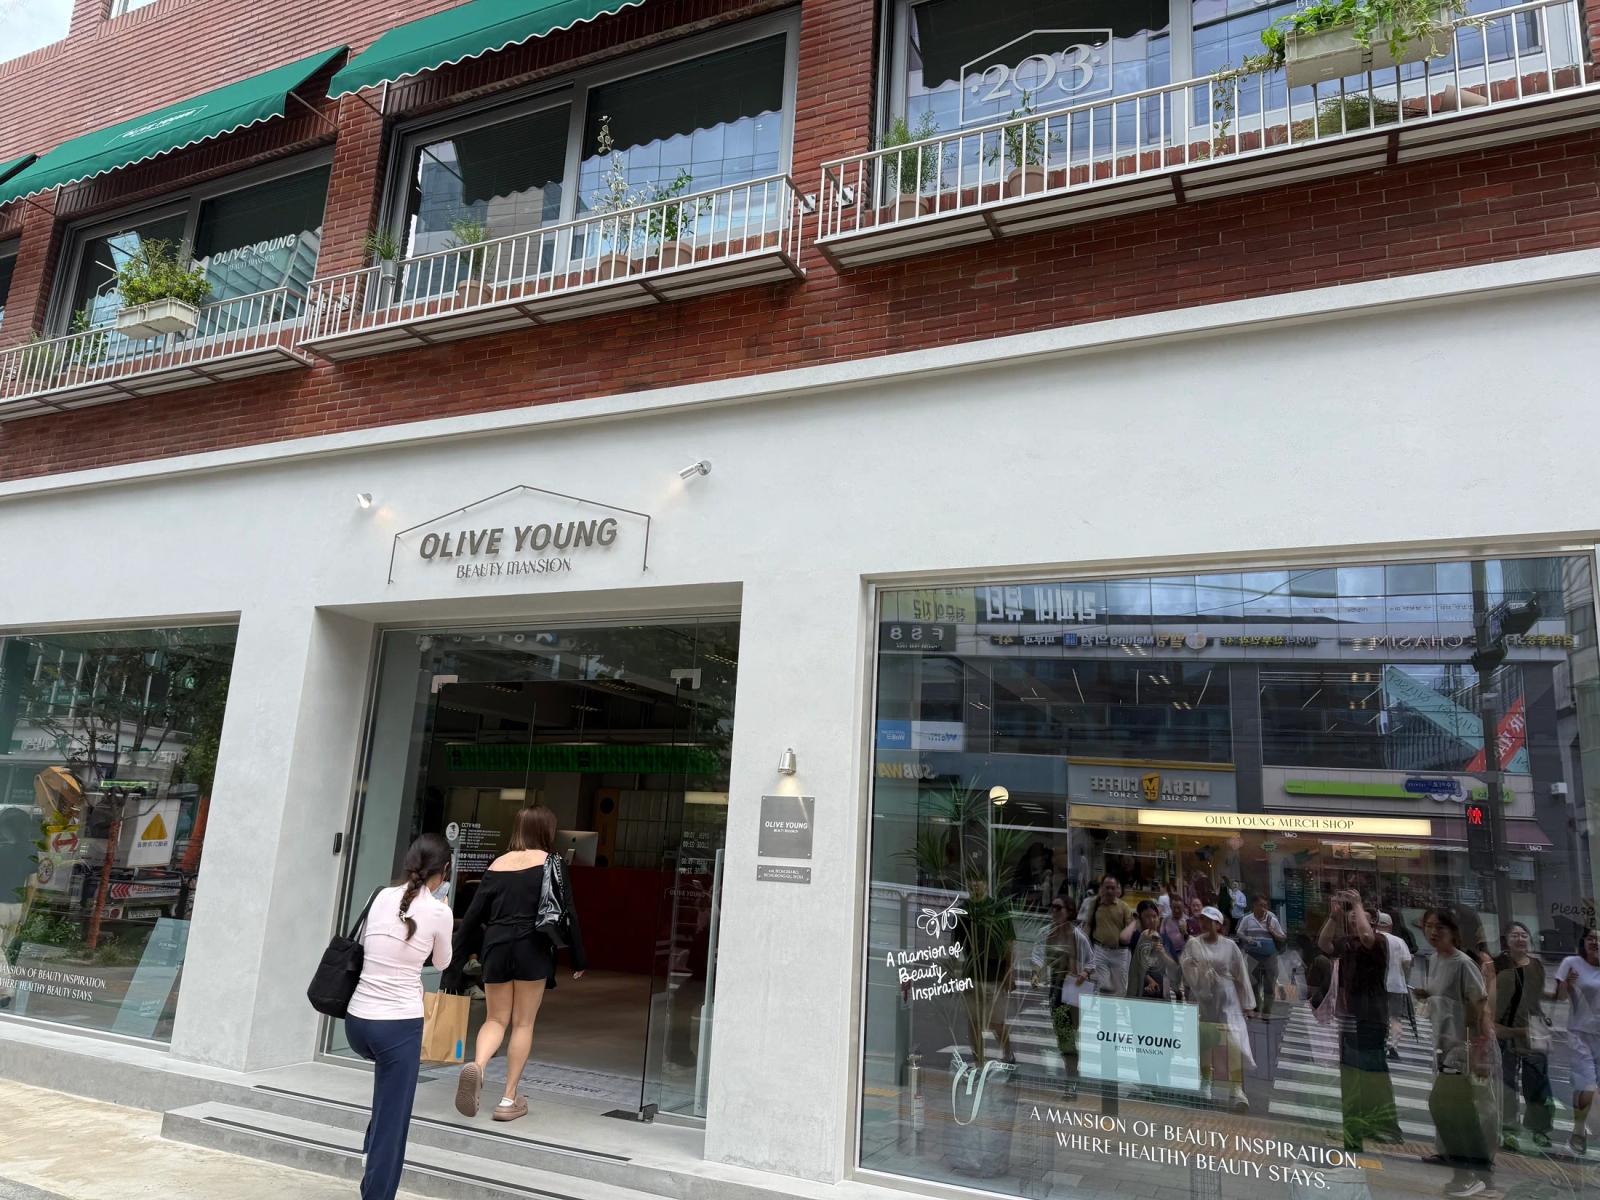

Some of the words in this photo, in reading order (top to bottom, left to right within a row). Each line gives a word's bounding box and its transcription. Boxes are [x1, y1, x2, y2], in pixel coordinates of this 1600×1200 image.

[213, 244, 250, 268] OLIVE
[251, 233, 297, 257] YOUNG
[419, 527, 504, 560] OLIVE
[514, 518, 618, 552] YOUNG
[456, 562, 504, 579] BEAUTY
[507, 557, 572, 576] MANSION
[765, 820, 784, 829] OLIVE
[786, 821, 809, 830] YOUNG
[1205, 815, 1234, 825] OLIVE
[1236, 816, 1276, 827] YOUNG
[1278, 818, 1319, 829] MERCH
[1322, 819, 1355, 830] SHOP
[1552, 902, 1595, 917] Please
[886, 953, 896, 967] A
[897, 945, 946, 966] Mansion
[947, 941, 964, 961] of
[27, 967, 37, 978] OF
[38, 969, 63, 983] BEAUTY
[62, 973, 107, 990] INSPIRATION.
[898, 963, 948, 985] Beauty
[19, 980, 46, 995] HEALTHY
[47, 984, 71, 998] BEAUTY
[72, 988, 94, 1002] STAYS.
[911, 977, 974, 1001] Inspiration
[1096, 1030, 1134, 1045] OLIVE
[1137, 1035, 1182, 1050] YOUNG
[1136, 1047, 1165, 1057] MANSION
[1029, 1106, 1041, 1121] A
[1045, 1108, 1127, 1134] MANSION
[1132, 1120, 1158, 1139] OF
[1165, 1125, 1230, 1150] BEAUTY
[1235, 1135, 1363, 1170] INSPIRATION.
[1056, 1131, 1111, 1155] WHERE
[1119, 1140, 1193, 1168] HEALTHY
[1196, 1153, 1262, 1181] BEAUTY
[1269, 1164, 1331, 1191] STAYS.
